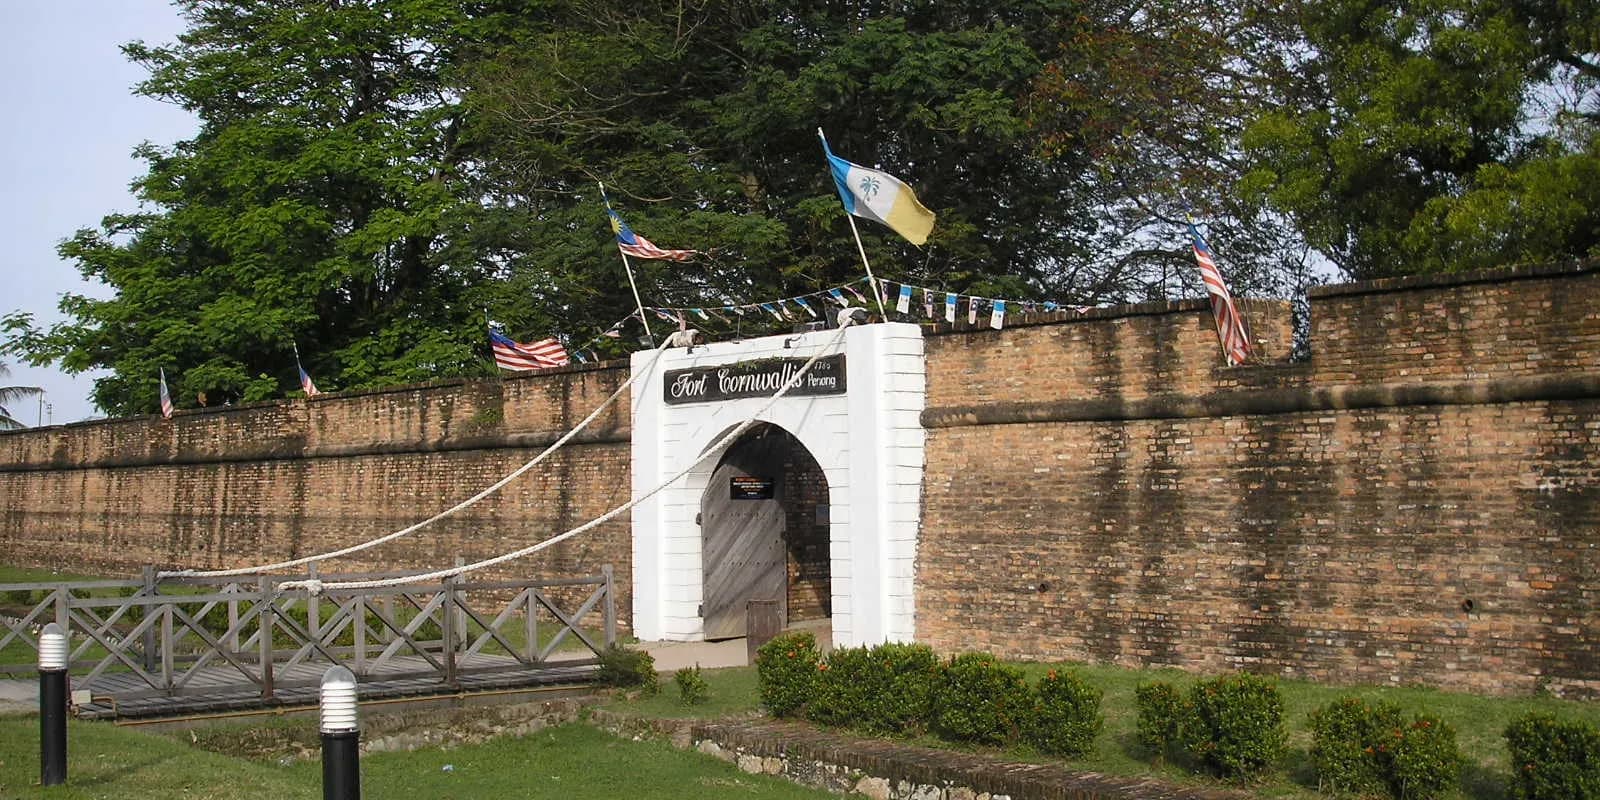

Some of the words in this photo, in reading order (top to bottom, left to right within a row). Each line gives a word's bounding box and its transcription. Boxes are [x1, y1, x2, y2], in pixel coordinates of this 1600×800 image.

[671, 373, 708, 398] Fort
[718, 362, 803, 394] Cornwallis
[808, 373, 836, 388] Penang
